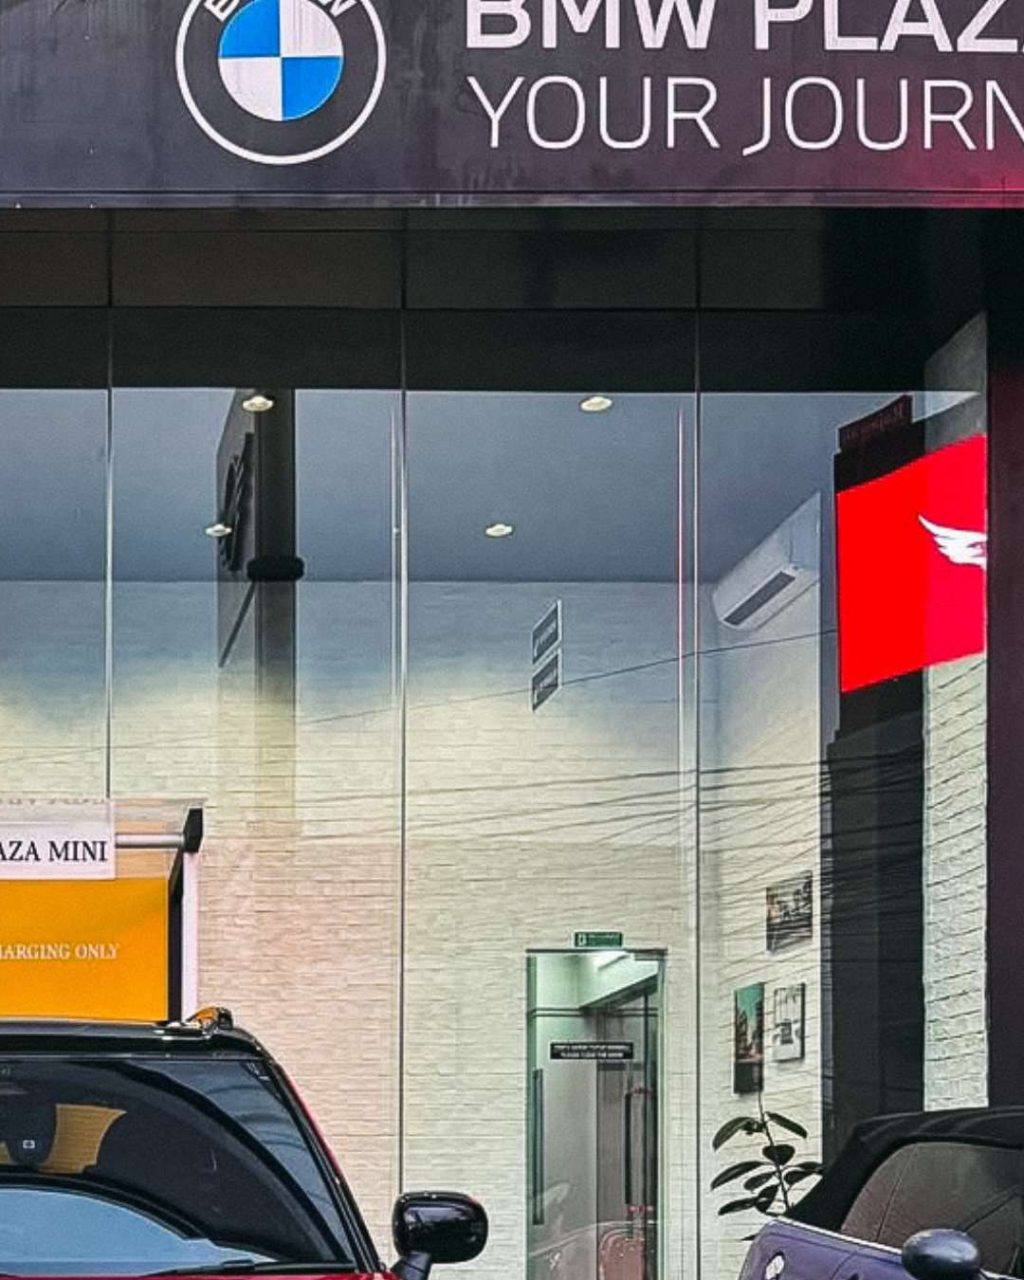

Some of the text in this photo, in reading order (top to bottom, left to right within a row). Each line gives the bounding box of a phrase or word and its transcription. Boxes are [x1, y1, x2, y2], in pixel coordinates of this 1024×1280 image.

[466, 0, 1024, 53] BMW PLAZ
[466, 75, 720, 149] YOUR
[49, 840, 107, 862] MINI
[75, 944, 119, 960] ONLY
